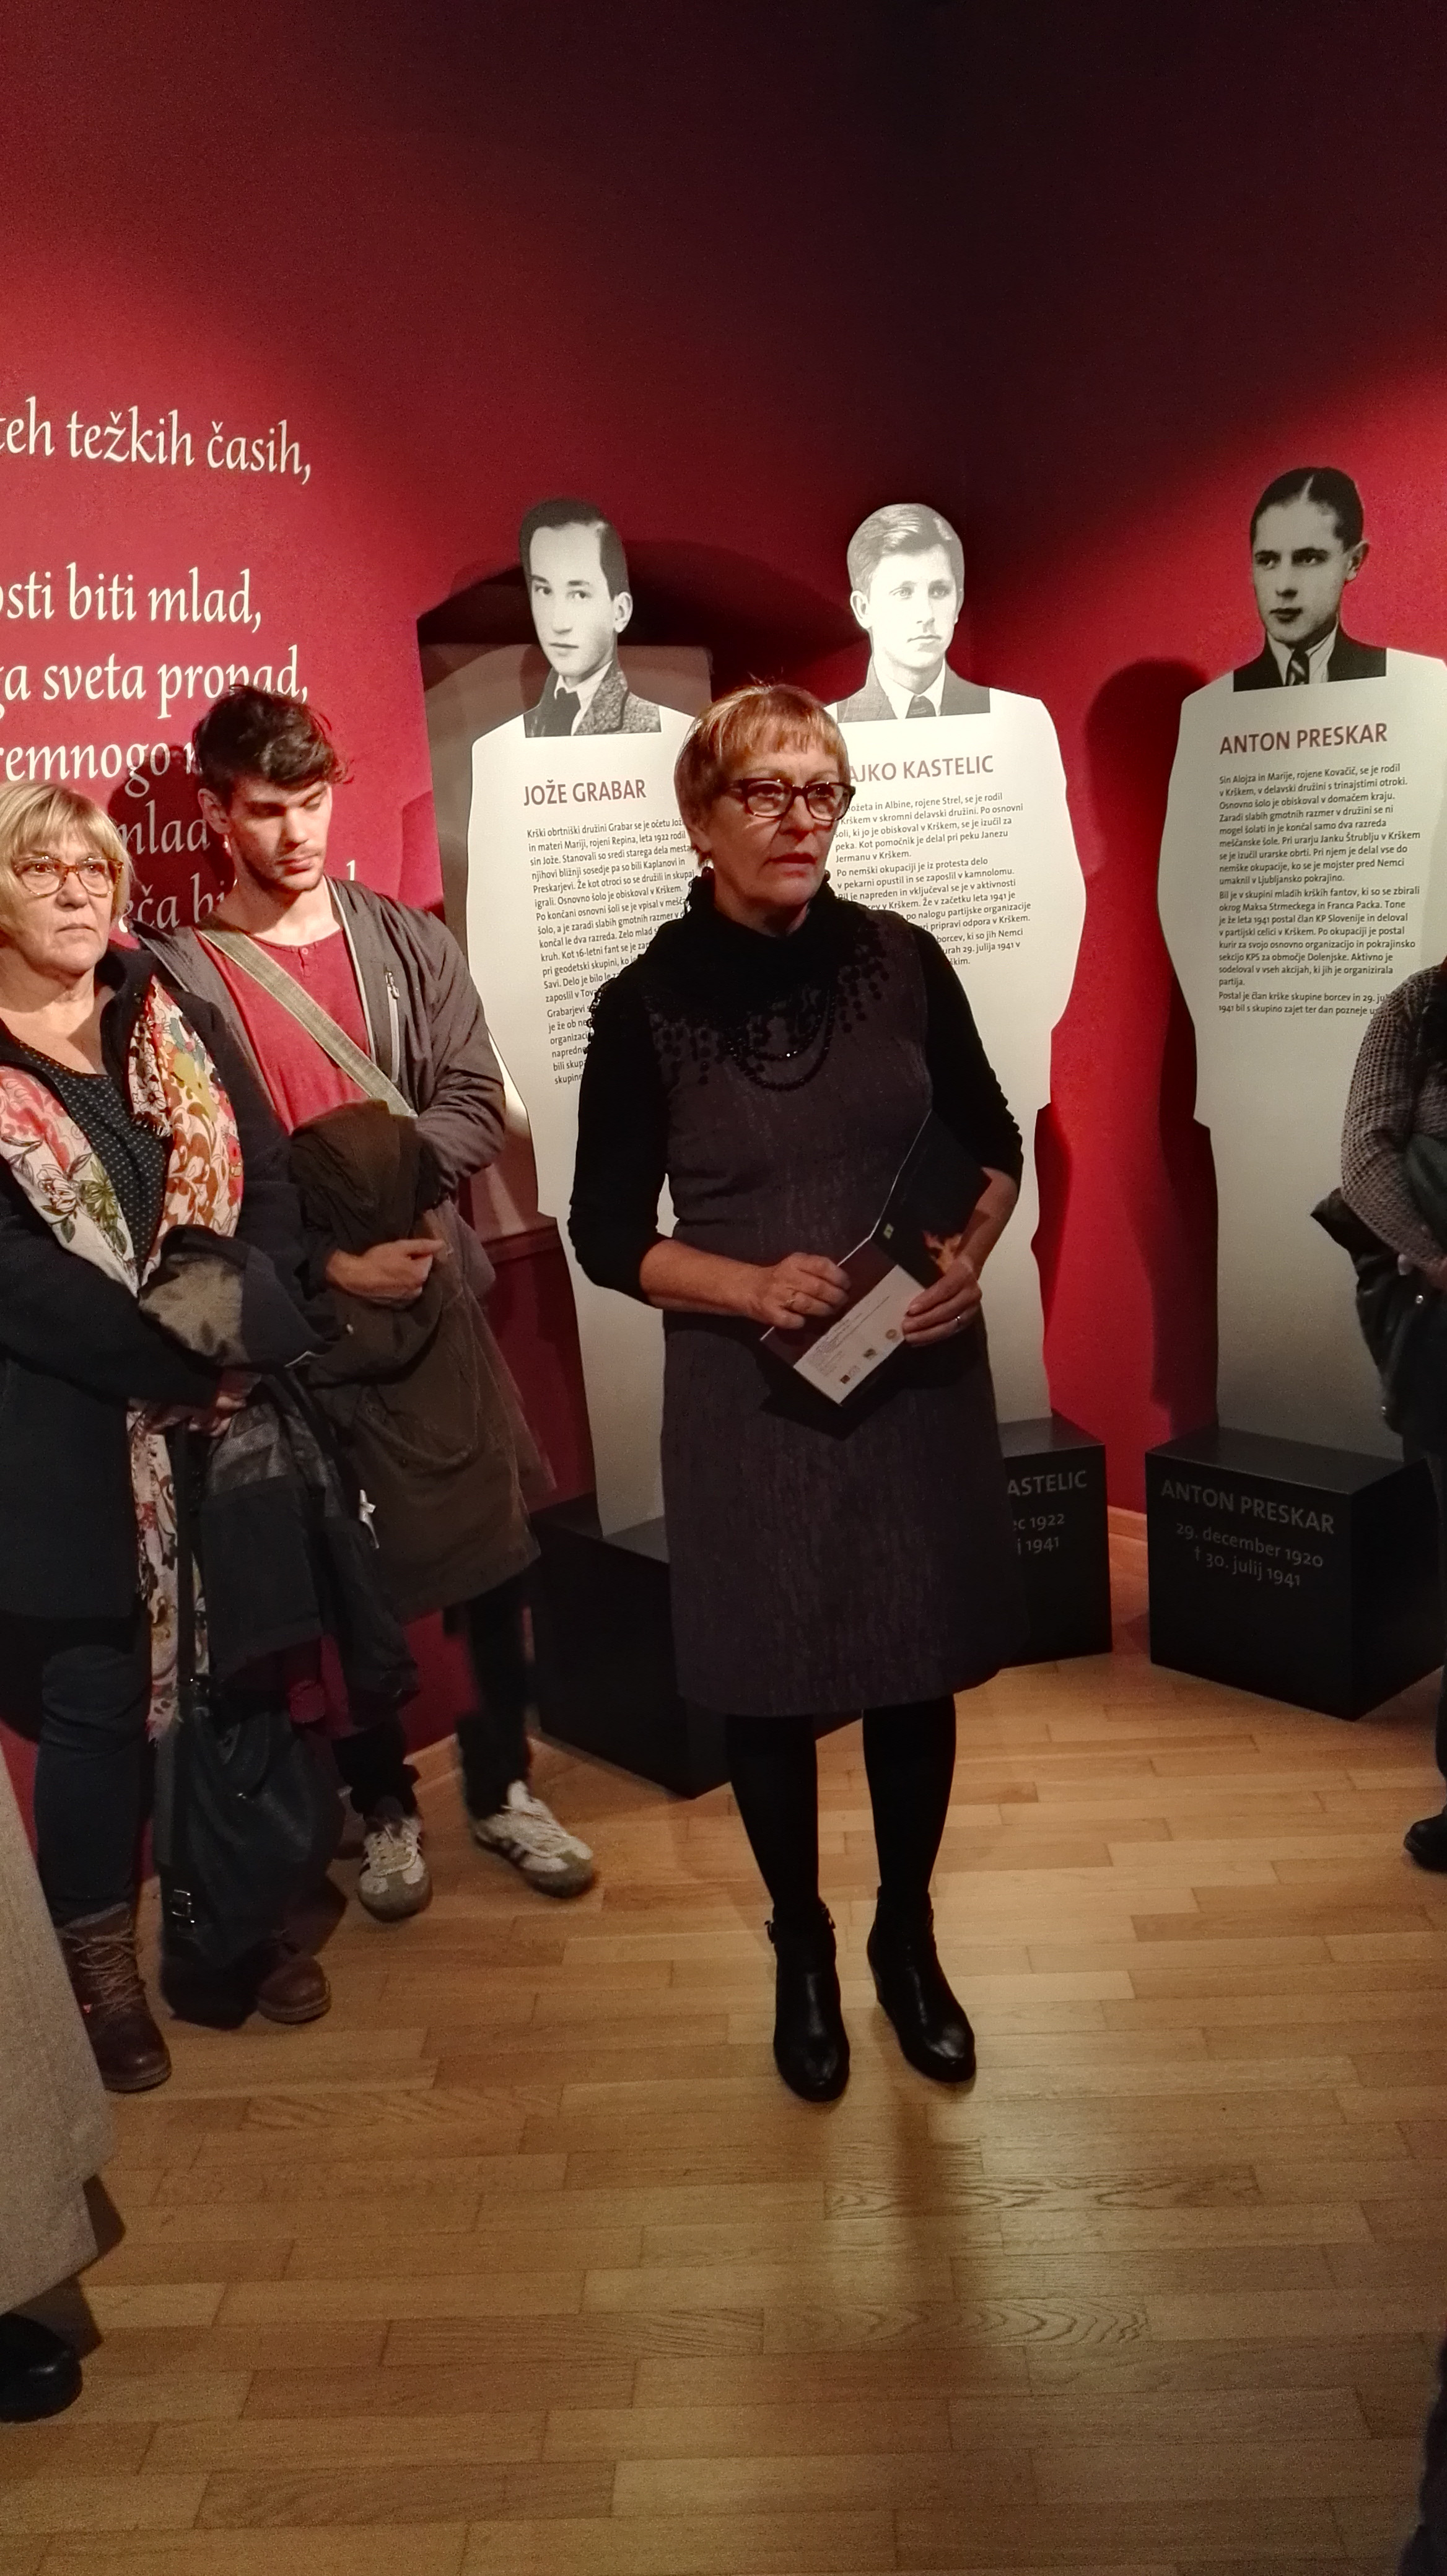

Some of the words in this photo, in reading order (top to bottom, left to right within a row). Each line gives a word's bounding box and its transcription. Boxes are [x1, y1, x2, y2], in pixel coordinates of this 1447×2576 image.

[0, 396, 55, 456] eh
[67, 406, 195, 466] težkih
[206, 419, 312, 485] časih,
[0, 571, 55, 620] sti
[66, 562, 137, 620] biti
[148, 567, 261, 633] mlad,
[0, 665, 32, 720] a
[43, 653, 147, 700] sveta
[1219, 730, 1290, 755] ANTON
[1296, 722, 1388, 749] PRESKAR
[0, 742, 170, 798] emnogo
[849, 762, 897, 783] AJKO
[903, 755, 994, 780] KASTELIC
[524, 779, 567, 806] JOŽE
[572, 779, 647, 803] GRABAR
[1225, 786, 1256, 798] Krškem,
[1263, 784, 1296, 794] delavski
[1297, 782, 1326, 792] družini
[1333, 780, 1378, 792] trinajstimi
[1379, 777, 1408, 787] otroki.
[1218, 799, 1253, 809] Osnovno
[1254, 798, 1271, 807] šolo
[1272, 798, 1280, 809] je
[1280, 796, 1319, 806] obiskoval
[1327, 793, 1368, 803] domačem
[1370, 791, 1395, 803] kraju.
[840, 814, 870, 825] Krškem
[879, 811, 912, 822] skromni
[914, 809, 946, 819] delavski
[948, 806, 978, 817] družini.
[980, 806, 990, 814] Po
[991, 803, 1023, 814] osnovni
[527, 829, 546, 838] Krški
[547, 826, 580, 837] obrtniški
[581, 824, 606, 833] družini
[608, 822, 632, 832] Grabar
[643, 820, 650, 831] je
[650, 819, 670, 828] očetu
[671, 817, 683, 827] Jož
[528, 844, 536, 852] in
[537, 842, 562, 851] materi
[564, 839, 588, 851] Mariji,
[589, 838, 610, 850] rojeni
[611, 835, 638, 848] Repina,
[639, 833, 652, 843] leta
[654, 835, 669, 844] 1922
[670, 831, 686, 840] rodil
[835, 840, 857, 853] peka.
[859, 839, 873, 848] Kot
[875, 836, 915, 850] pomočnik
[916, 835, 924, 846] je
[925, 833, 945, 843] delal
[946, 833, 958, 844] pri
[960, 830, 979, 843] peku
[981, 829, 1008, 838] Janezu
[530, 858, 541, 866] sin
[542, 855, 561, 865] Jože.
[562, 852, 597, 863] Stanovali
[607, 850, 625, 859] sredi
[626, 848, 652, 859] starega
[653, 845, 668, 855] dela
[835, 852, 870, 863] Jermanu
[878, 849, 911, 859] Krškem.
[836, 868, 847, 877] Po
[848, 865, 878, 876] nemški
[879, 862, 916, 876] okupaciji
[917, 862, 925, 872] je
[927, 861, 933, 869] iz
[935, 858, 969, 871] protesta
[970, 856, 988, 866] delo
[1218, 863, 1249, 872] nemške
[1249, 862, 1290, 874] okupacije,
[1291, 861, 1301, 870] ko
[1313, 861, 1321, 871] je
[1322, 860, 1355, 871] mojster
[1355, 859, 1375, 870] pred
[1376, 858, 1405, 867] Nemci
[531, 869, 557, 882] njihovi
[558, 867, 581, 880] bližnji
[582, 864, 610, 877] sosedje
[611, 866, 620, 875] pa
[631, 861, 642, 871] bili
[643, 858, 677, 871] Kaplanovi
[678, 858, 685, 866] in
[844, 878, 874, 891] pekarni
[876, 876, 904, 888] opustil
[906, 875, 914, 884] in
[925, 871, 956, 884] zaposlil
[964, 866, 1015, 879] kamnolomu.
[1219, 876, 1250, 885] umaknil
[1257, 874, 1303, 886] Ljubljansko
[1303, 873, 1345, 884] pokrajino.
[534, 897, 556, 910] igrali.
[557, 894, 590, 905] Osnovno
[591, 892, 606, 902] šolo
[608, 892, 614, 902] je
[615, 887, 649, 899] obiskoval
[655, 884, 684, 895] Krškem.
[1218, 903, 1241, 914] okrog
[1242, 902, 1267, 911] Maksa
[1269, 902, 1316, 913] Strmeckega
[1317, 902, 1326, 910] in
[1326, 900, 1354, 909] Franca
[1355, 900, 1383, 908] Packa.
[1384, 899, 1405, 908] Tone
[906, 914, 917, 923] po
[917, 909, 946, 921] nalogu
[947, 905, 982, 919] partijske
[983, 902, 1031, 916] organizacije
[1218, 941, 1237, 949] kurir
[1248, 941, 1269, 951] svojo
[1305, 940, 1355, 951] organizacijo
[1365, 939, 1416, 950] pokrajinsko
[1007, 1469, 1088, 1497] ASTELIC
[1161, 1479, 1234, 1512] ANTON
[1240, 1495, 1334, 1534] PRESKAR
[1030, 1513, 1065, 1531] 1922
[1026, 1536, 1059, 1554] 1941
[1177, 1523, 1198, 1540] 29.
[1203, 1526, 1281, 1557] december
[1285, 1549, 1324, 1567] 1920
[1205, 1553, 1229, 1569] 30.
[1231, 1555, 1264, 1582] julij
[1267, 1567, 1301, 1588] 1941
